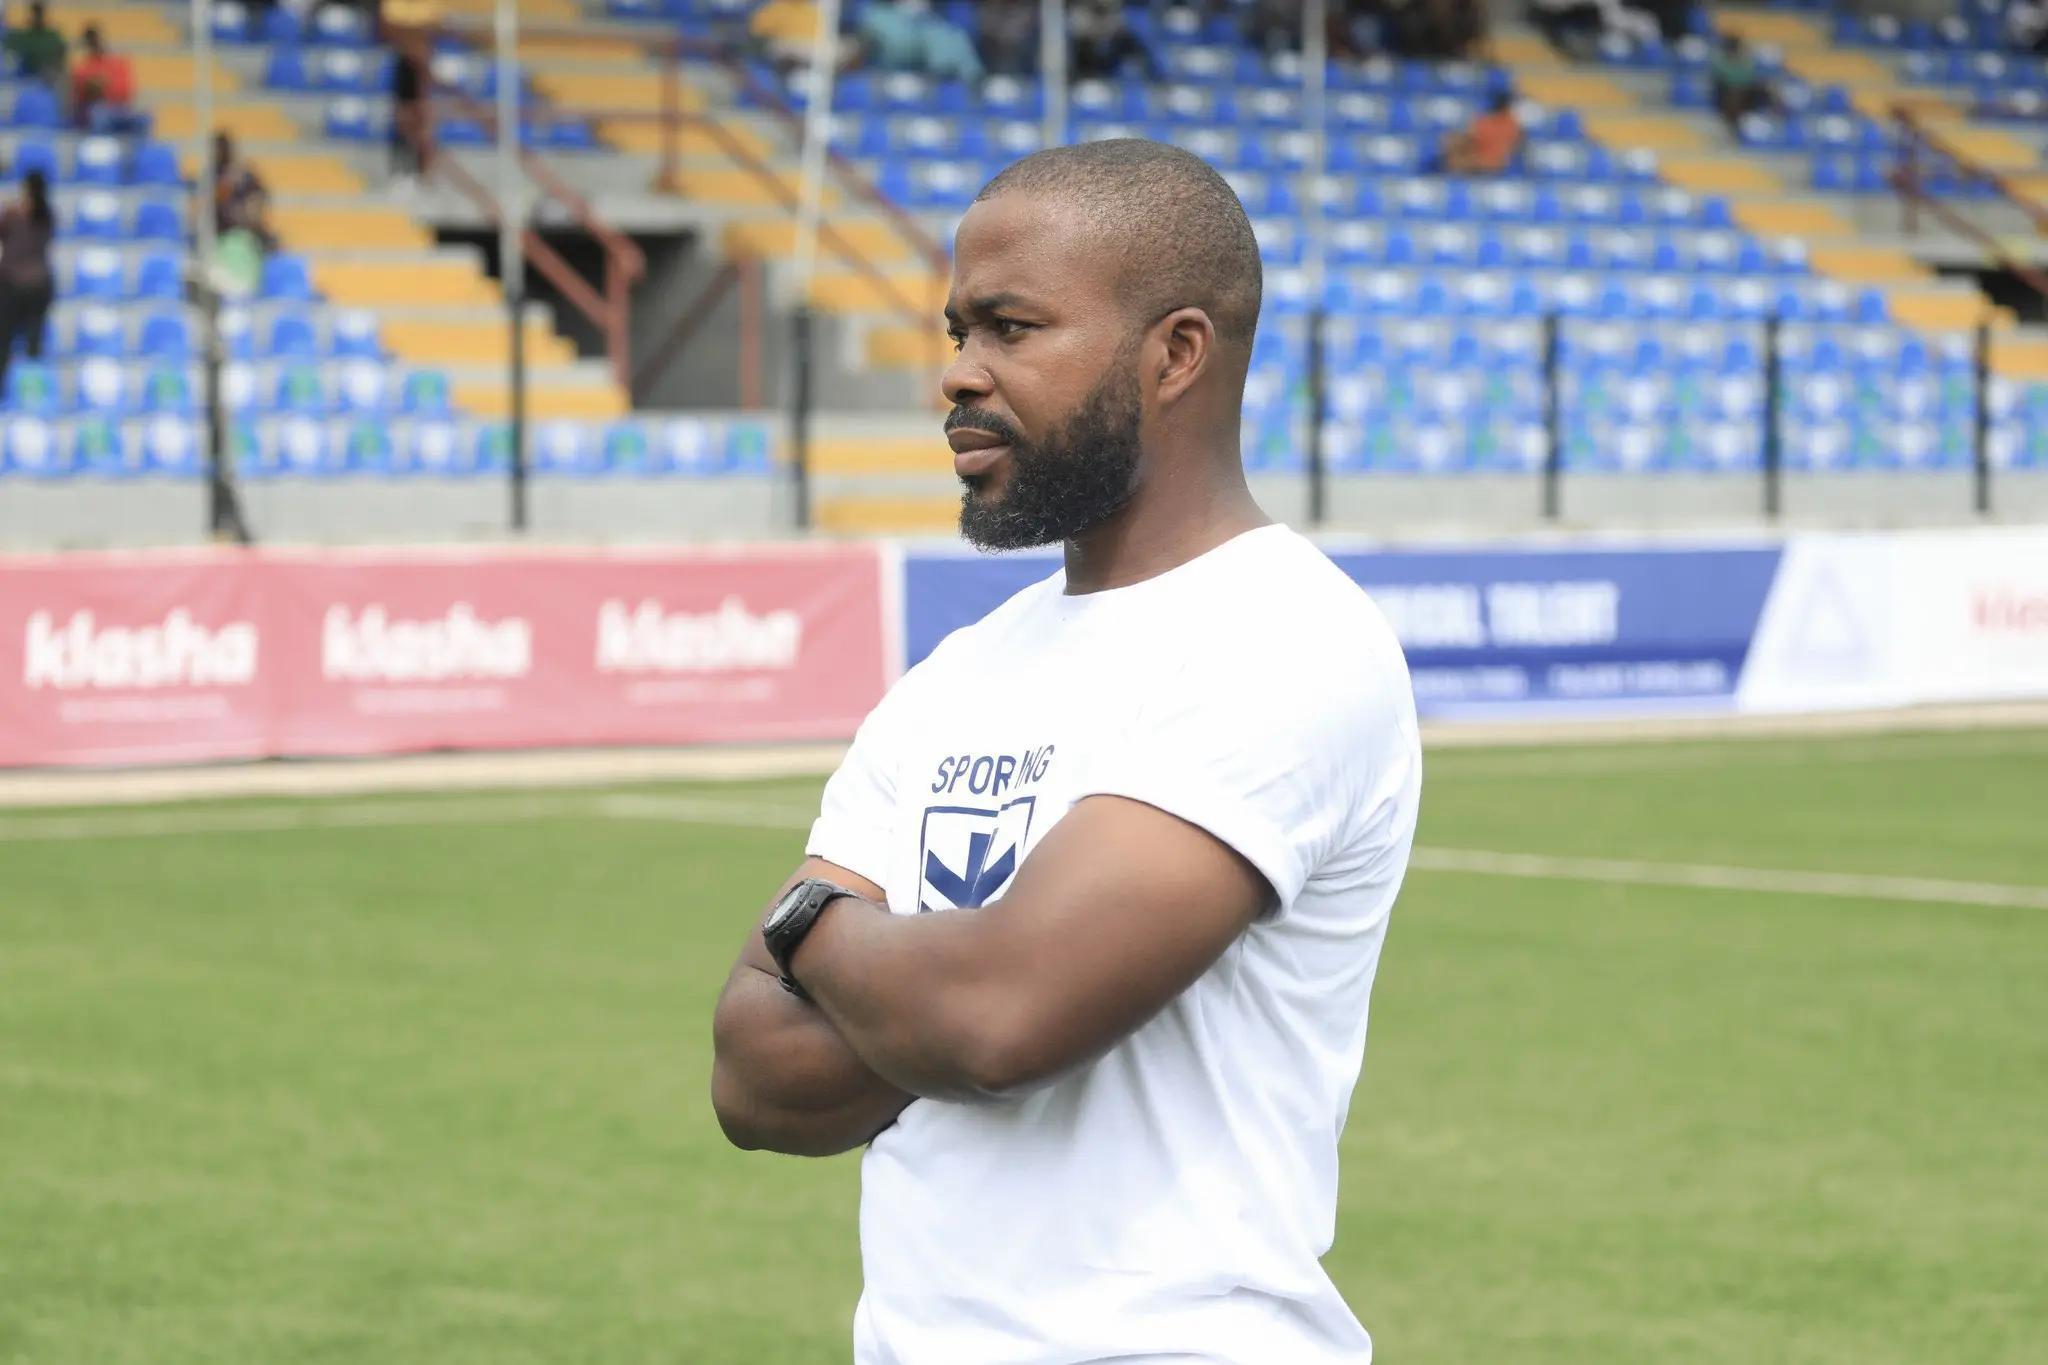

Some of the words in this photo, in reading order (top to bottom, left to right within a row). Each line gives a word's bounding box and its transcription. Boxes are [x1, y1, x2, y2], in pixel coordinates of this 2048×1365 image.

[24, 607, 259, 690] klasha
[322, 601, 532, 682] klasha
[596, 595, 801, 671] klasha
[931, 744, 1055, 796] SPORING
